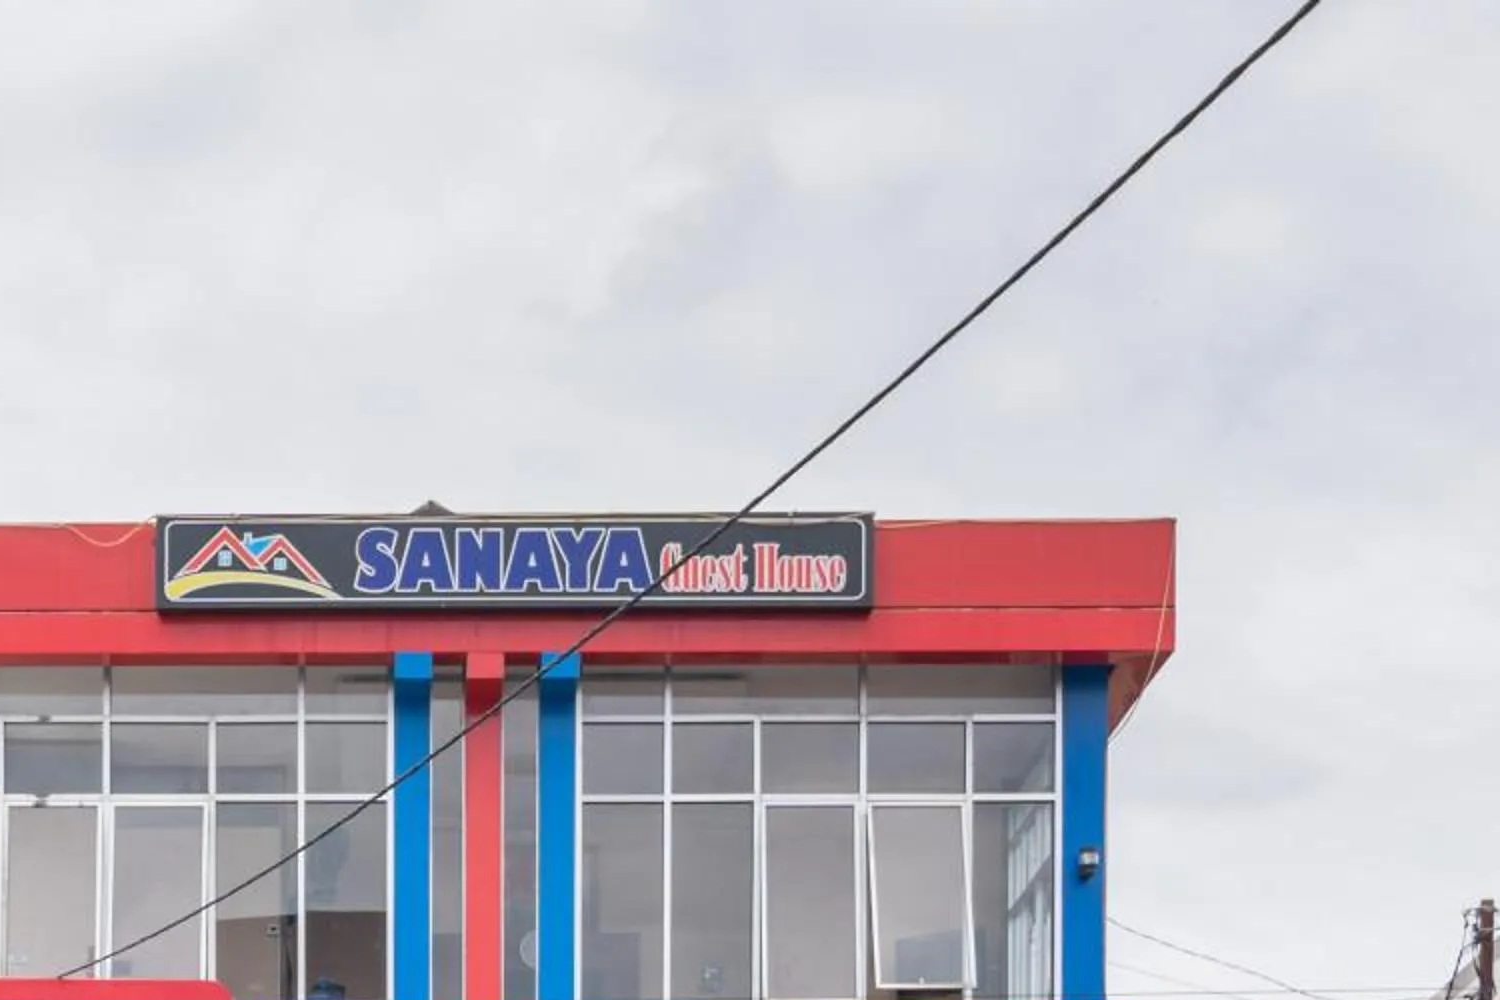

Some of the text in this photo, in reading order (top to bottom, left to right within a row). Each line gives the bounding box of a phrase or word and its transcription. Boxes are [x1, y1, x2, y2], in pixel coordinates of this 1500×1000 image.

[354, 527, 848, 594] SANAYA Guest House
